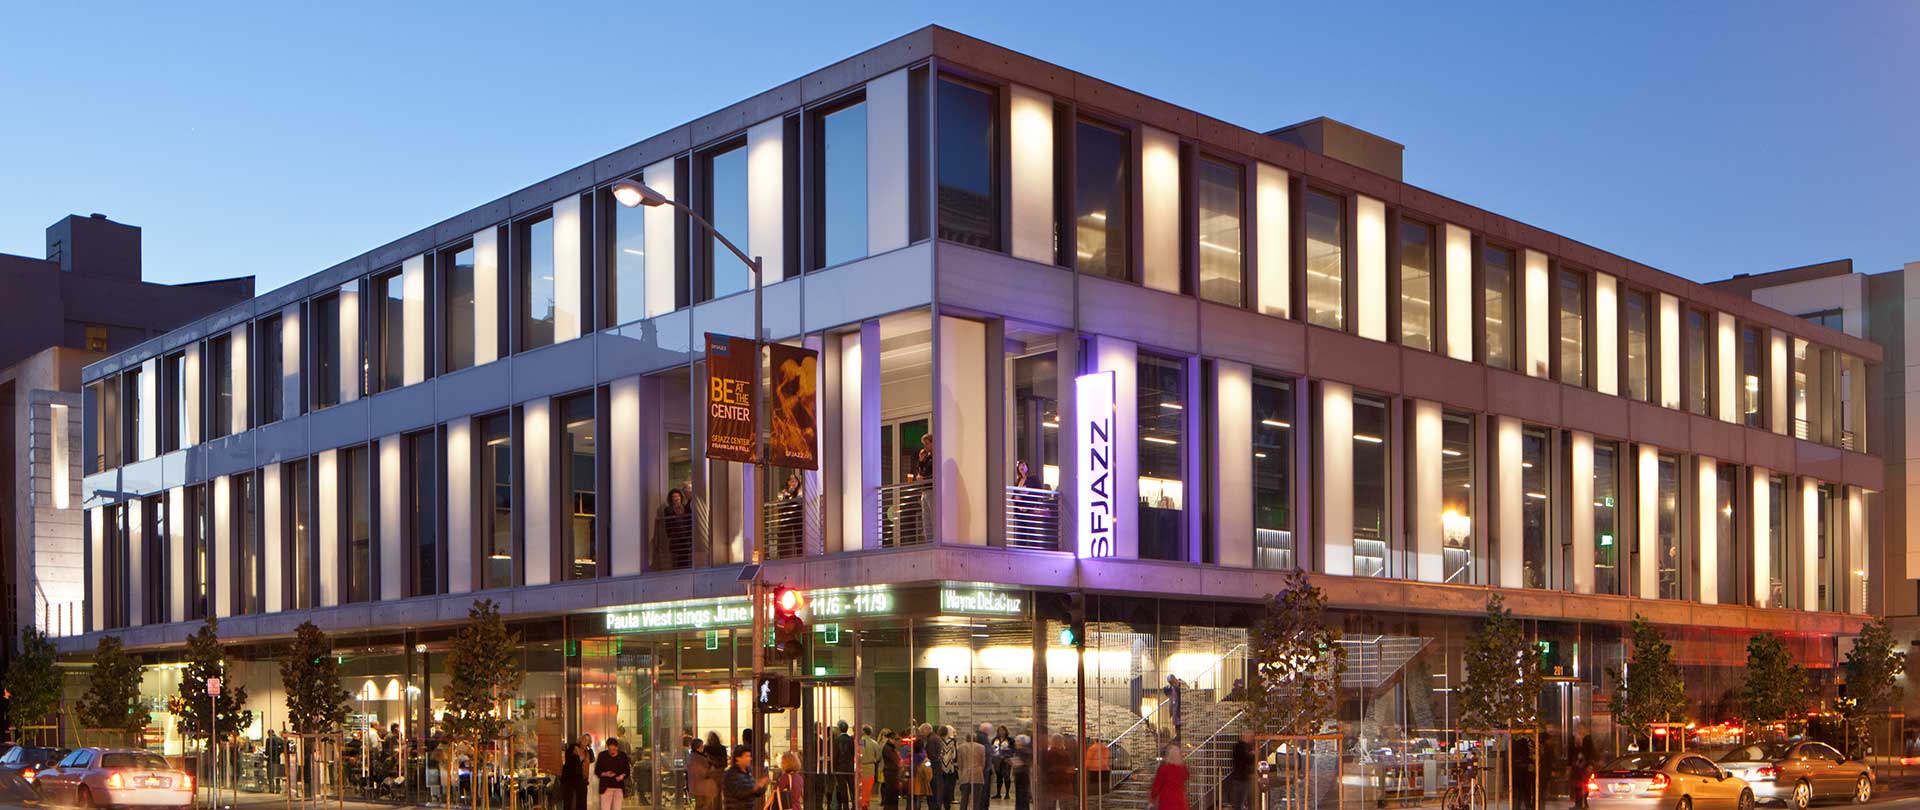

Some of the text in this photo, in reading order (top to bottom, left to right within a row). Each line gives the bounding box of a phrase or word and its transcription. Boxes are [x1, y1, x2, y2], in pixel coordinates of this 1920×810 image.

[711, 376, 735, 404] BE
[735, 382, 745, 393] AT
[735, 393, 749, 404] THE
[711, 403, 750, 422] CENTER
[731, 436, 750, 446] CENTER
[1091, 418, 1109, 558] SFJAZZ
[809, 596, 840, 616] 11/6
[853, 593, 887, 613] 11/9
[945, 589, 1021, 612] Wayne DeLaCruz
[606, 613, 639, 630] Paula
[641, 609, 672, 627] West
[676, 608, 710, 628] sings
[713, 606, 747, 622] June
